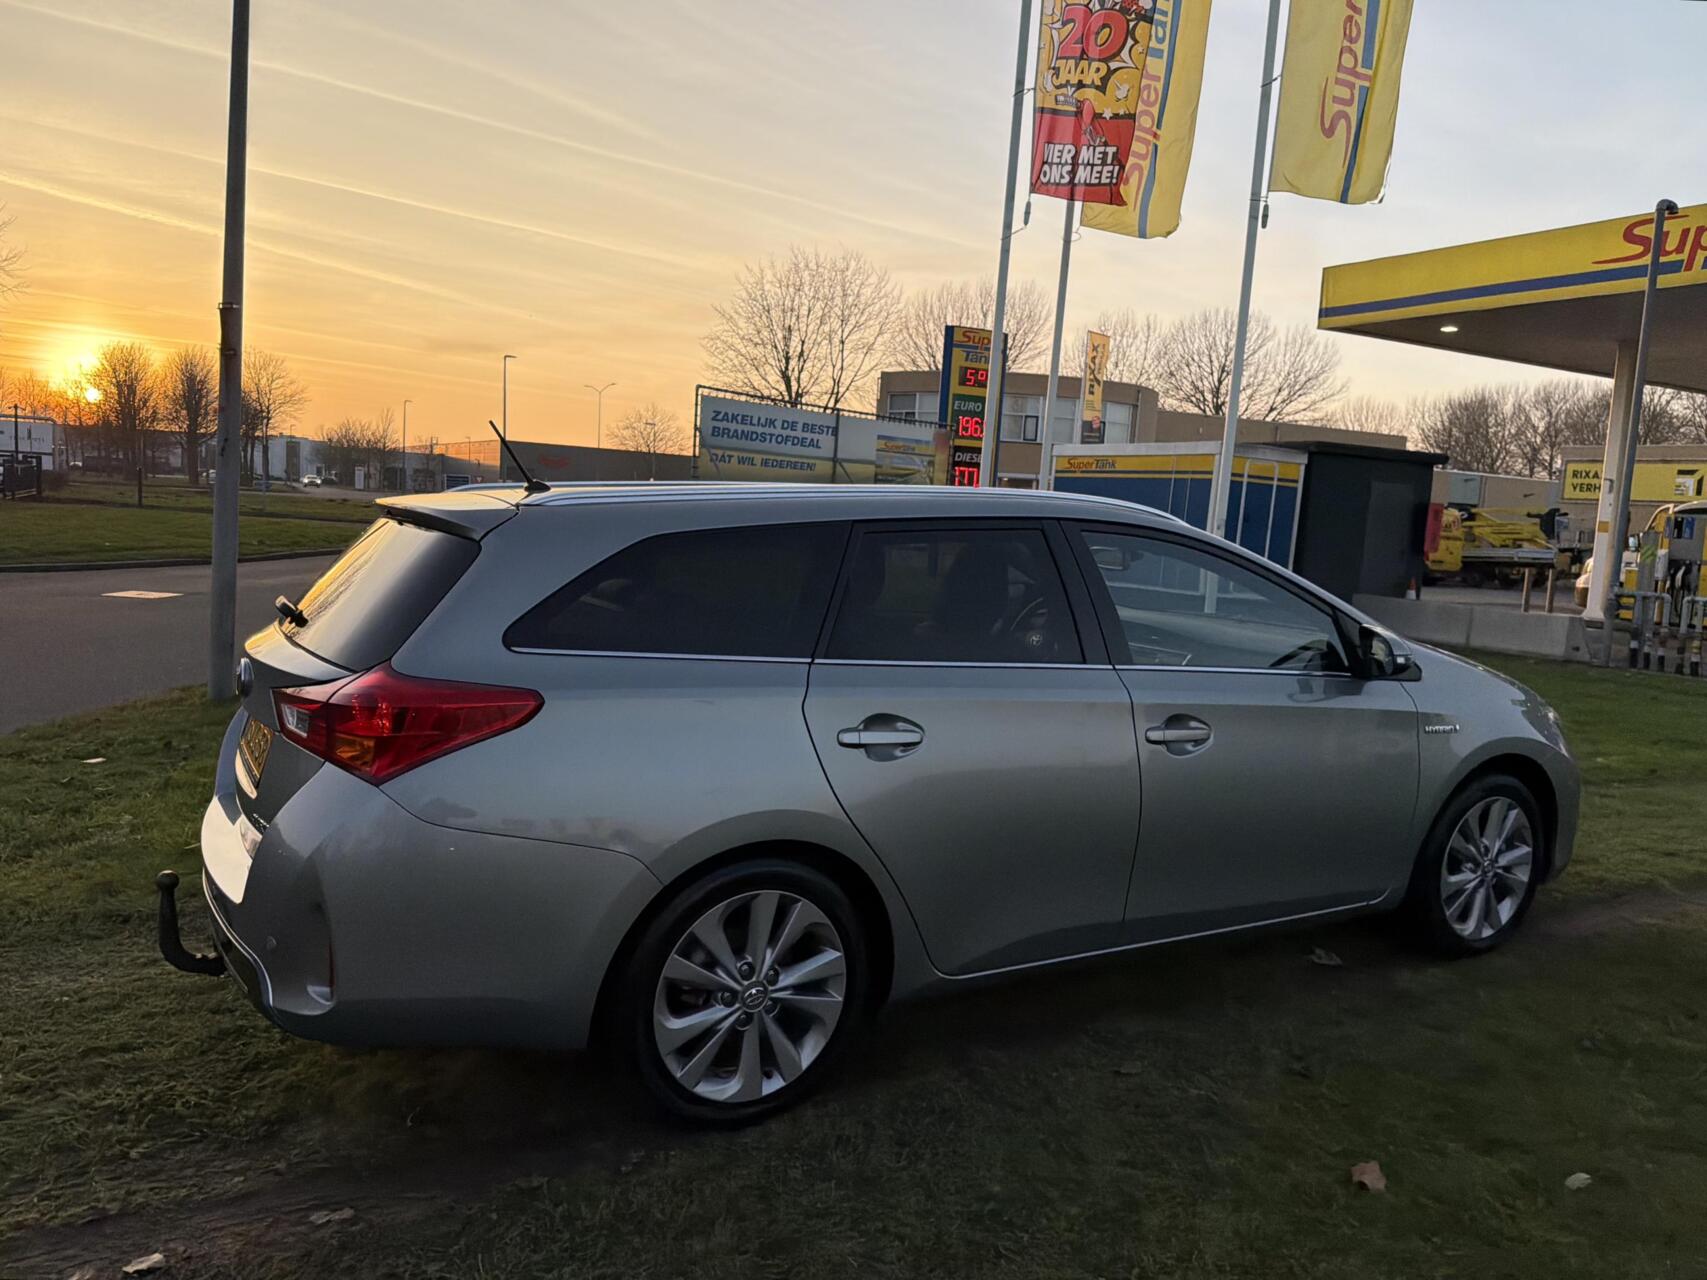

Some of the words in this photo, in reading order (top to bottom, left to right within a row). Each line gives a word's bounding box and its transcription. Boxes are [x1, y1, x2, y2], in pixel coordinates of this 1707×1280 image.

[1057, 4, 1130, 60] 20
[1055, 59, 1108, 86] JAAR
[1078, 145, 1117, 165] MET
[1040, 164, 1073, 184] ONS
[1074, 165, 1120, 184] MEE!
[954, 400, 982, 411] EURO
[711, 410, 777, 430] ZAKELIJK
[780, 419, 799, 432] DE
[711, 425, 822, 450] BRANDSTOFDEAL
[737, 455, 757, 467] WIL
[760, 459, 816, 472] IEDEREEN!
